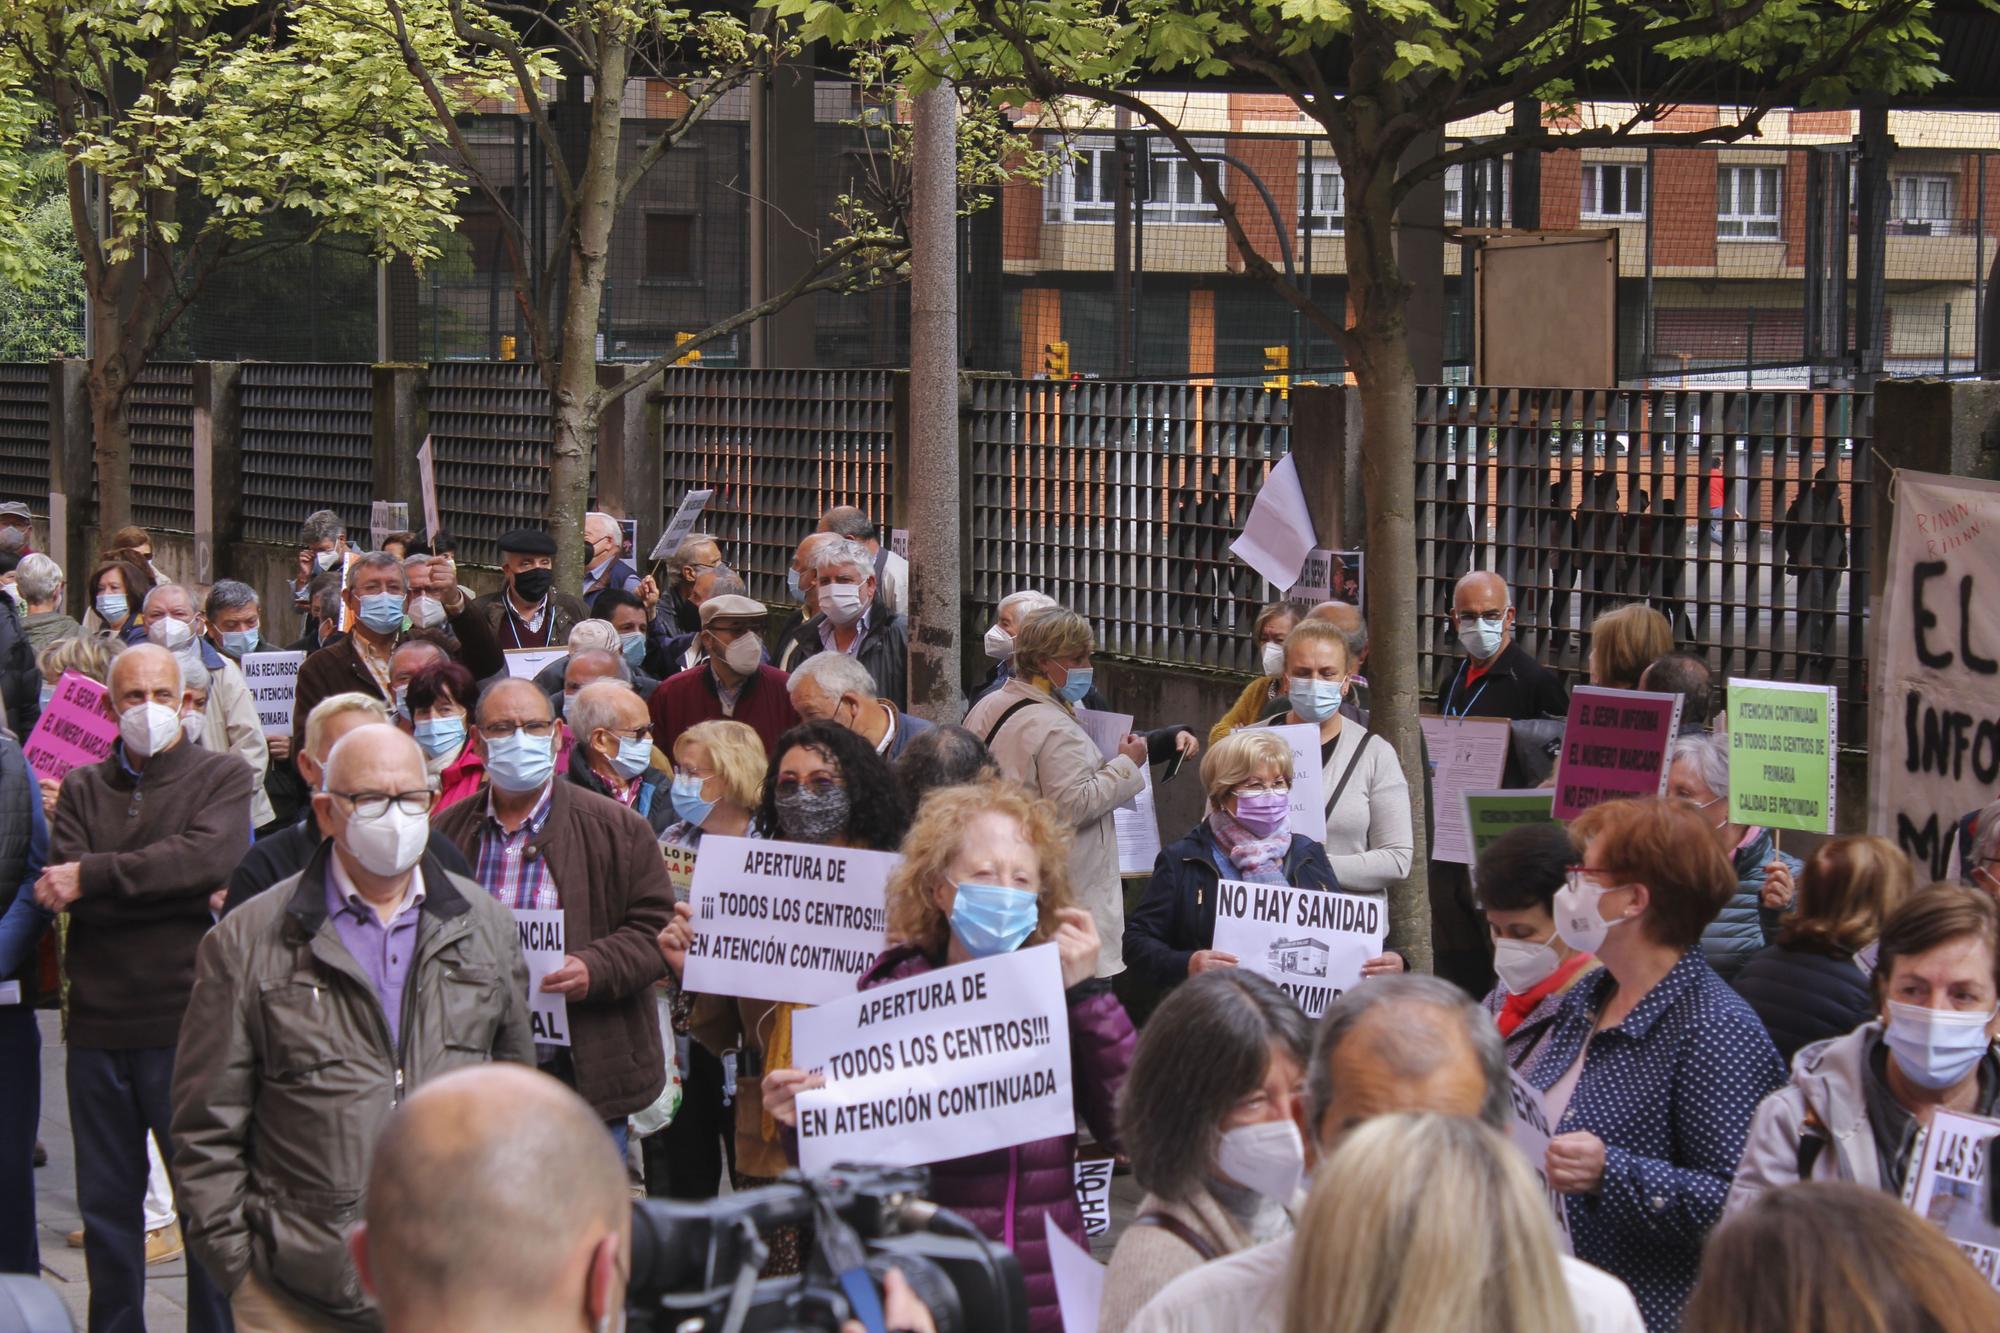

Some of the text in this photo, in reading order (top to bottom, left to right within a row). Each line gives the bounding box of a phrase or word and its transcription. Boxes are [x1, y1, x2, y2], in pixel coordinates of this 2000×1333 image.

[1913, 560, 1998, 675] EL
[246, 661, 298, 677] MÁS RECURSOS
[63, 681, 76, 701] EL
[260, 684, 294, 701] ATENCIÓN
[42, 712, 55, 732] EL
[1580, 704, 1591, 726] EL
[1568, 743, 1579, 766] EL
[1733, 732, 1825, 756] EN TODOS LOS CENTROS DE
[1763, 764, 1796, 784] PRIMARIA
[1739, 793, 1767, 812] CALIDAD
[1768, 796, 1778, 814] ES
[664, 847, 680, 860] LO
[744, 850, 847, 883] APERTURA DE
[719, 892, 768, 920] TODOS
[773, 897, 801, 923] LOS
[805, 900, 886, 932] CENTROS!!!
[1218, 883, 1379, 935] NO HAY SANIDAD
[515, 921, 563, 951] NCIAL
[688, 933, 710, 957] EN
[712, 935, 785, 967] ATENCIÓN
[857, 972, 988, 1029] APERTURA DE
[830, 1042, 896, 1082] TODOS
[899, 1033, 938, 1069] LOS
[942, 1015, 1051, 1061] CENTROS!!!
[801, 1067, 1058, 1138] EN ATENCIÓN CONTINUADA
[1935, 1130, 1969, 1177] LAS
